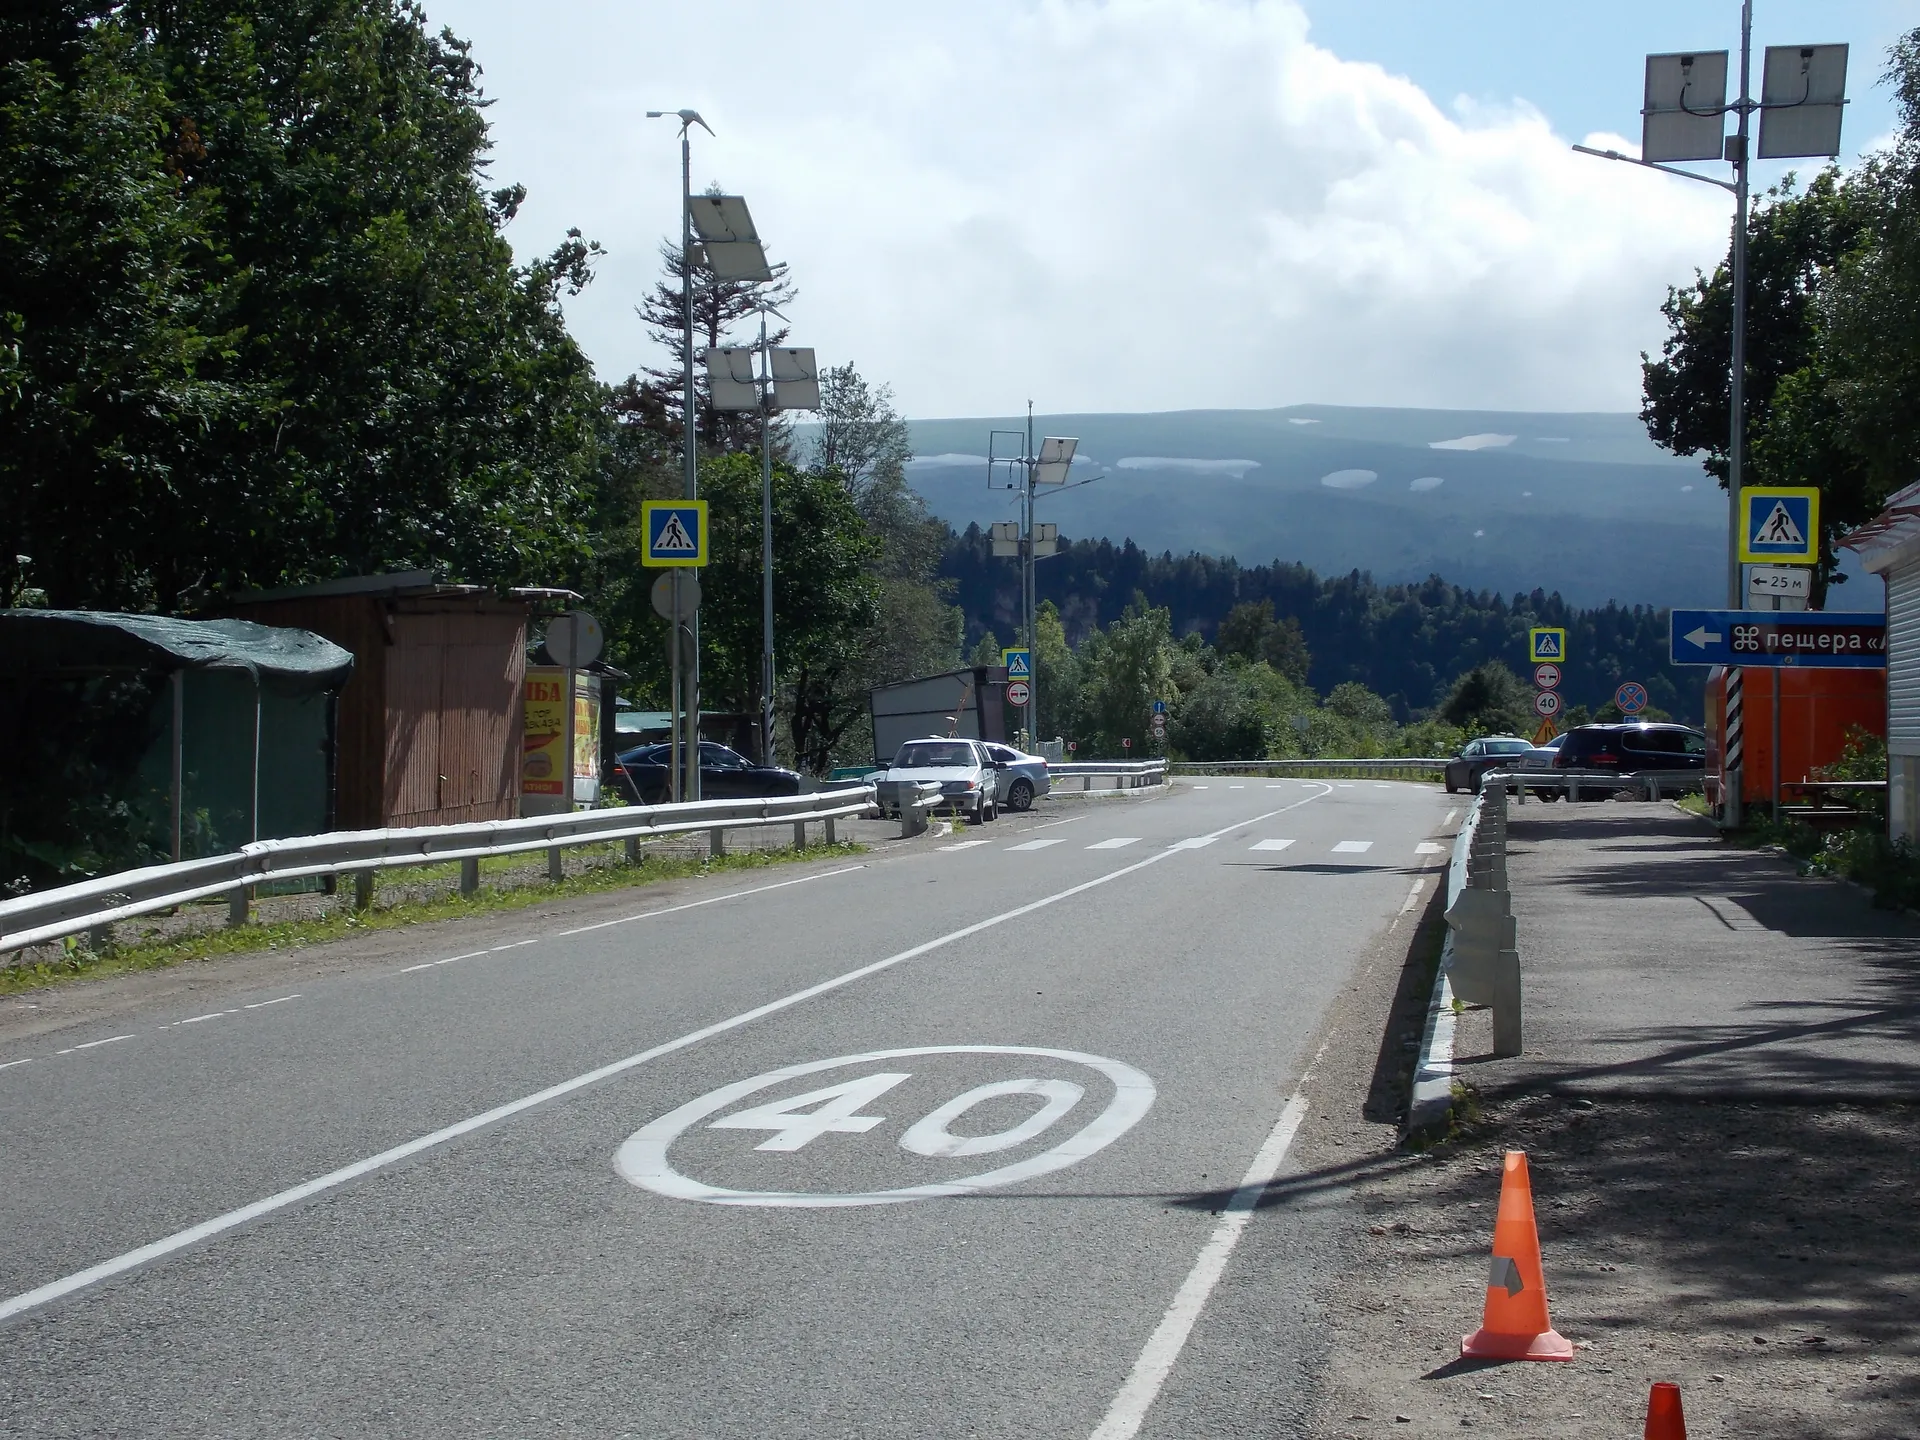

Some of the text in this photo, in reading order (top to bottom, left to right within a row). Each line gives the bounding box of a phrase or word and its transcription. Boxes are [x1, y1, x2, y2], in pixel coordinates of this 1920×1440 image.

[1771, 576, 1788, 588] 25
[1767, 633, 1862, 654] пещера
[1539, 697, 1555, 708] 40
[705, 1073, 1086, 1157] 40
